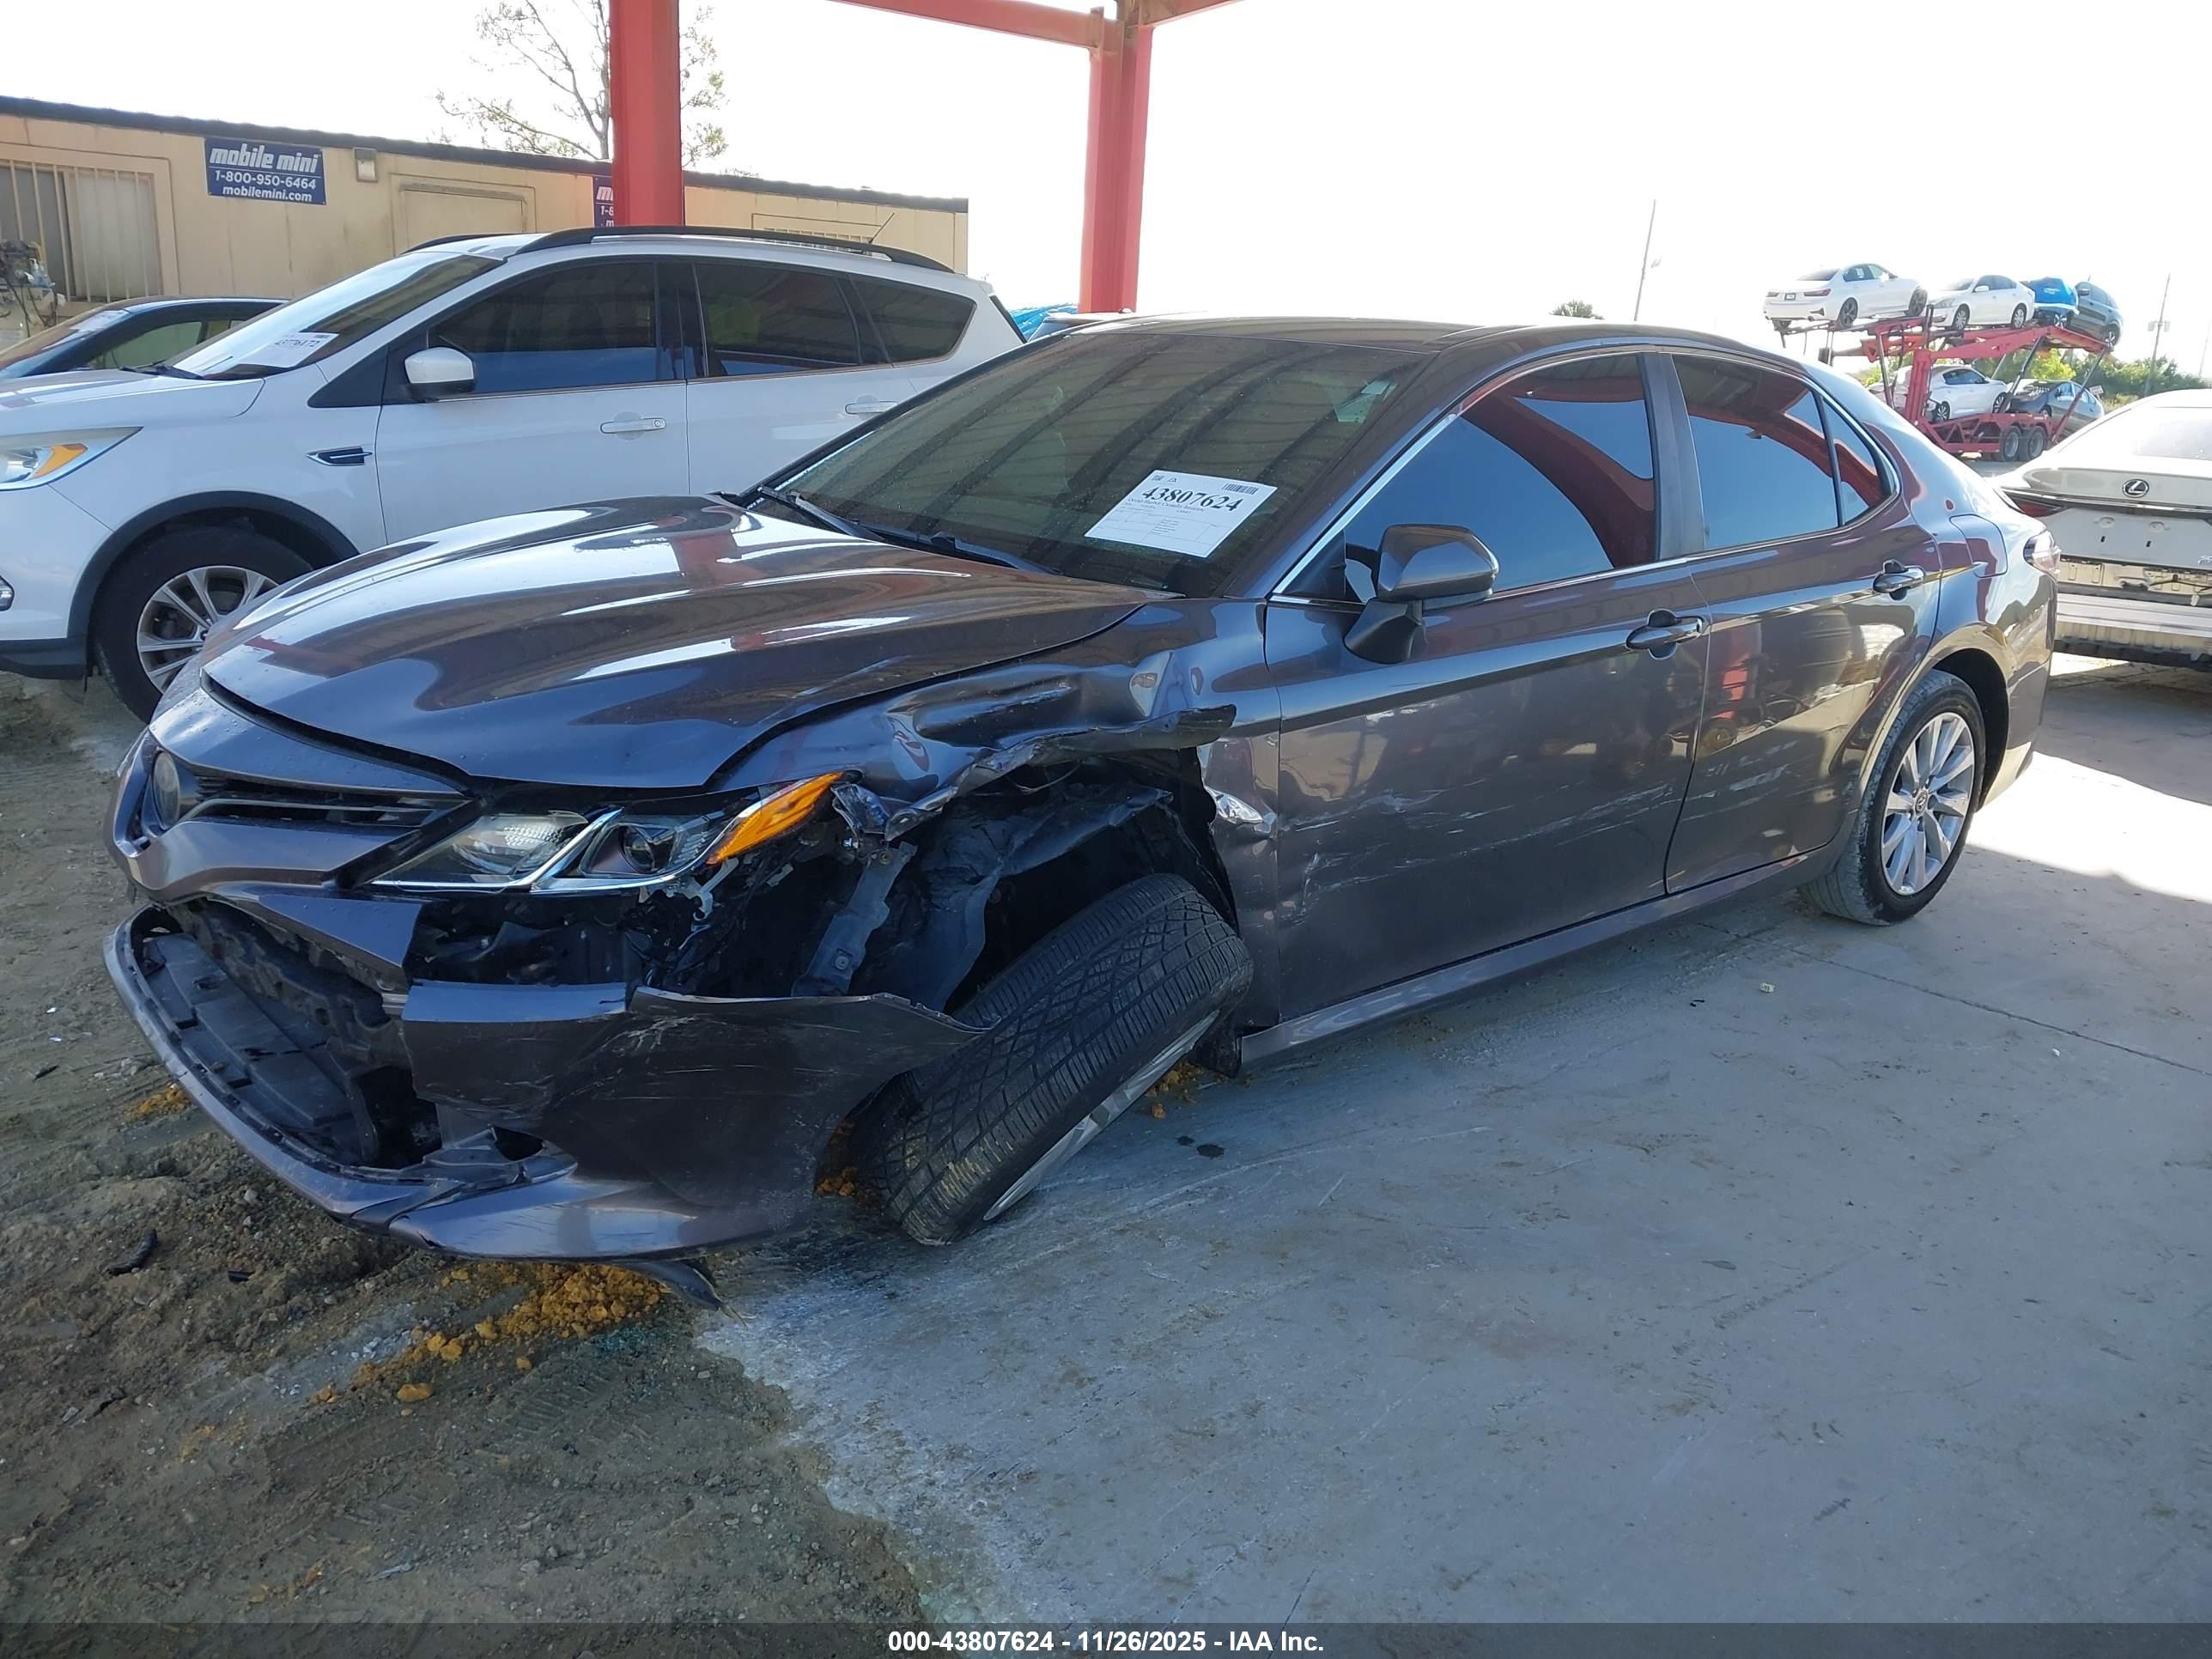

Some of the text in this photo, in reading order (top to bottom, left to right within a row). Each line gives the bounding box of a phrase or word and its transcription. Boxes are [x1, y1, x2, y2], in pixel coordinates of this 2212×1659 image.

[210, 143, 319, 173] mobile mini
[215, 170, 317, 190] 1-800-950-6464
[222, 185, 313, 203] mobilemini.com
[1141, 486, 1244, 512] 43807624
